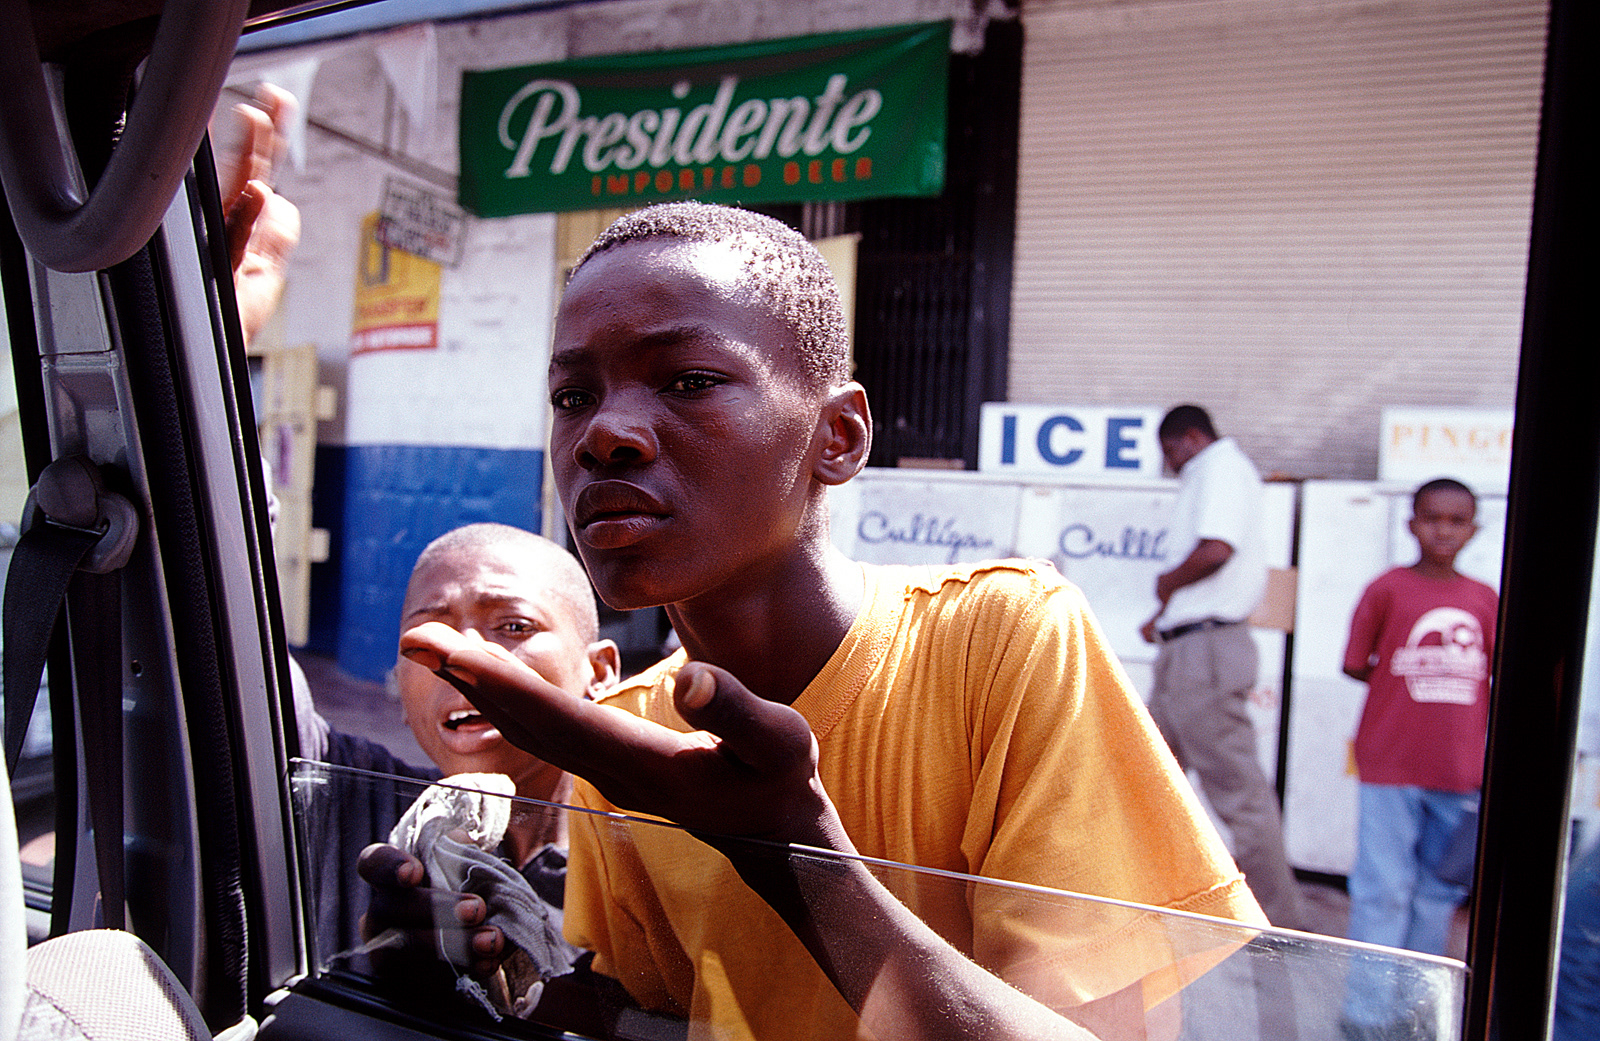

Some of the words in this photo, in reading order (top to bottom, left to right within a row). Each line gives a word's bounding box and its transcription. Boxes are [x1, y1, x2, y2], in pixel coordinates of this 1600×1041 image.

[498, 73, 882, 178] Presidente
[591, 164, 762, 197] IMPORTED
[783, 157, 873, 186] BEER
[1000, 415, 1144, 469] ICE
